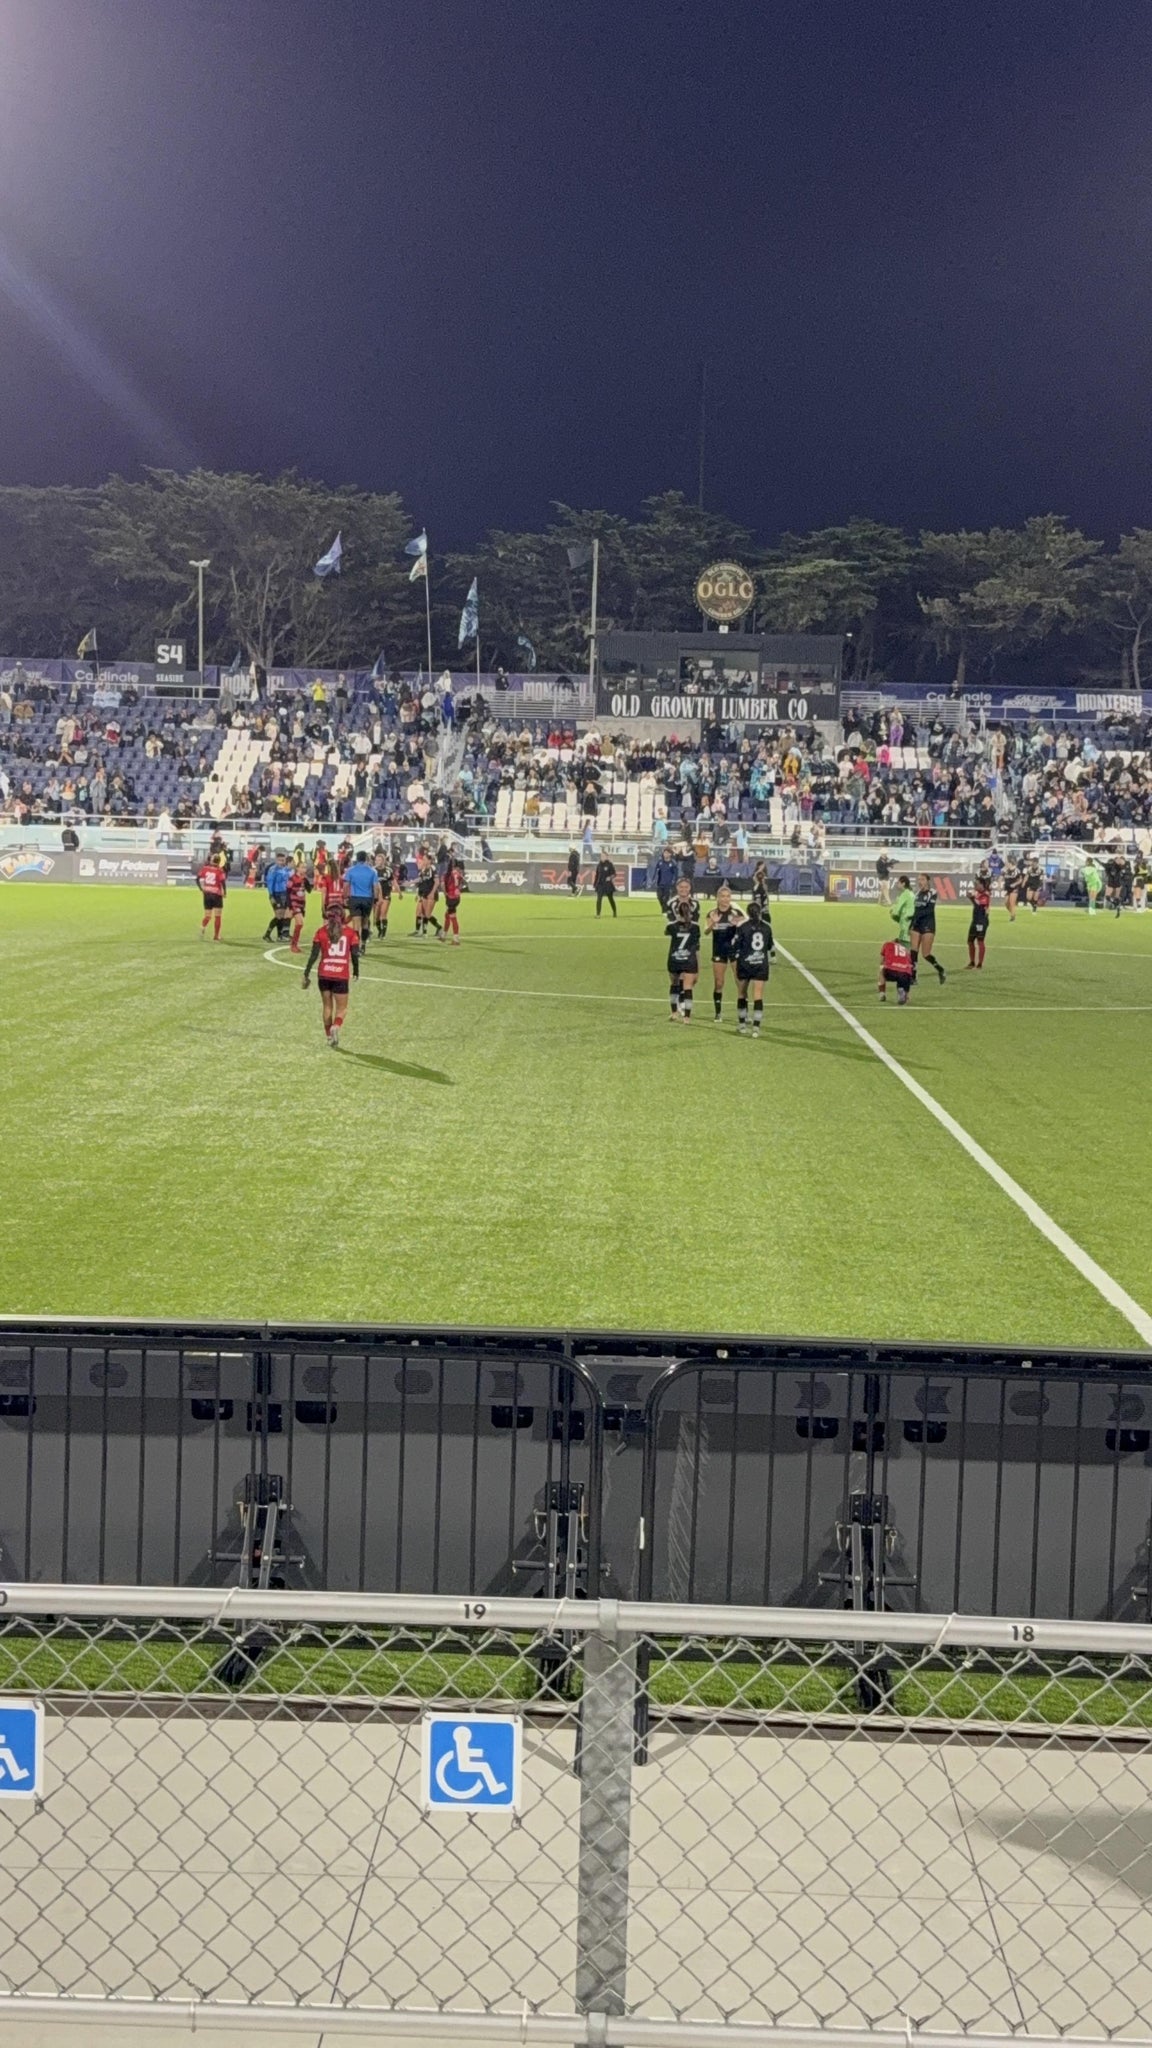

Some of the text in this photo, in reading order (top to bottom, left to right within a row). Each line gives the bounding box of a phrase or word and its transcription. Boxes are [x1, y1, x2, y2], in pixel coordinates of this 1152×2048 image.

[698, 582, 752, 598] OGLC
[157, 644, 182, 664] S4
[75, 670, 139, 683] Cadinale
[156, 674, 184, 683] SEASIDE
[926, 691, 992, 702] Canale
[611, 694, 640, 717] OLD
[651, 695, 714, 719] GROWTH
[722, 697, 778, 720] LUMBER
[99, 858, 160, 872] Bay Federal
[677, 933, 690, 949] 7
[751, 932, 764, 950] 8
[894, 944, 906, 956] 15
[464, 1603, 487, 1620] 19
[1011, 1625, 1034, 1642] 18
